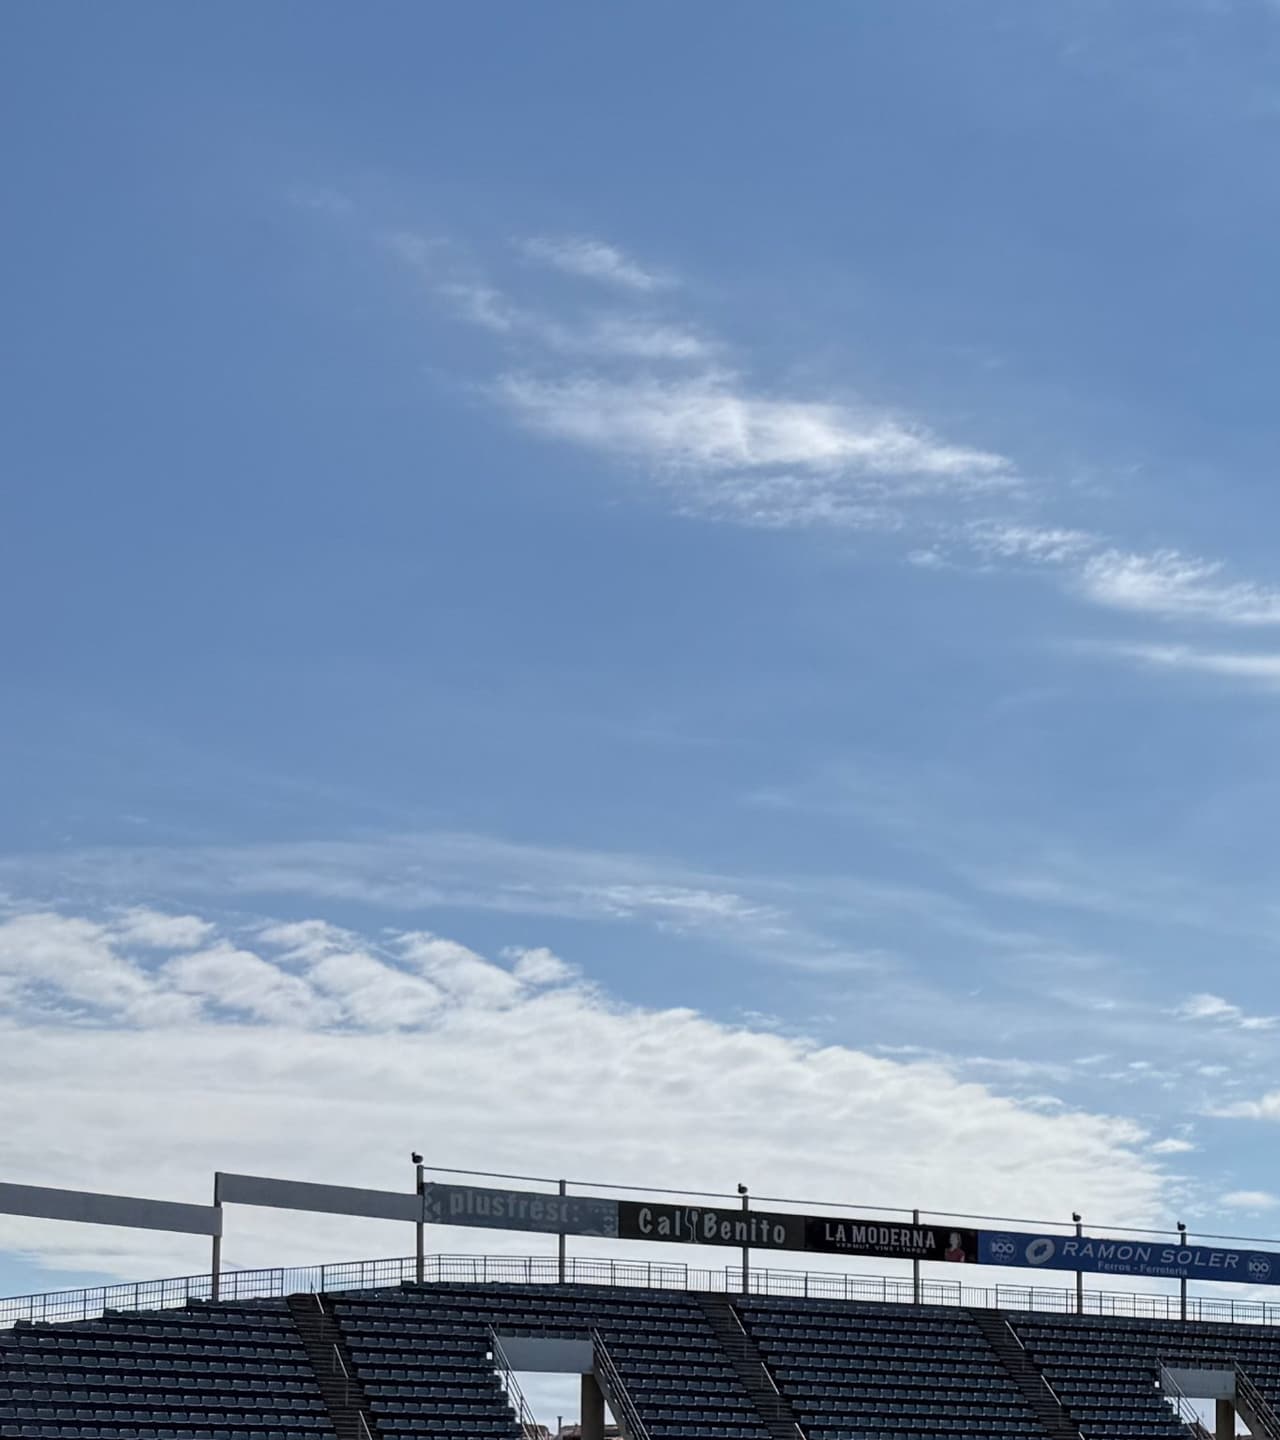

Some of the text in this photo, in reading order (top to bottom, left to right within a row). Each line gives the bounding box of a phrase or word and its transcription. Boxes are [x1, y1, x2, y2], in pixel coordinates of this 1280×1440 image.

[638, 1207, 786, 1244] Cal Benito
[825, 1223, 936, 1249] LA MODERNA
[991, 1242, 1014, 1253] 100
[1062, 1241, 1239, 1268] RAMON SOLER
[1097, 1260, 1130, 1271] Ferros
[1140, 1263, 1188, 1276] Ferreteria
[1248, 1262, 1269, 1273] 100
